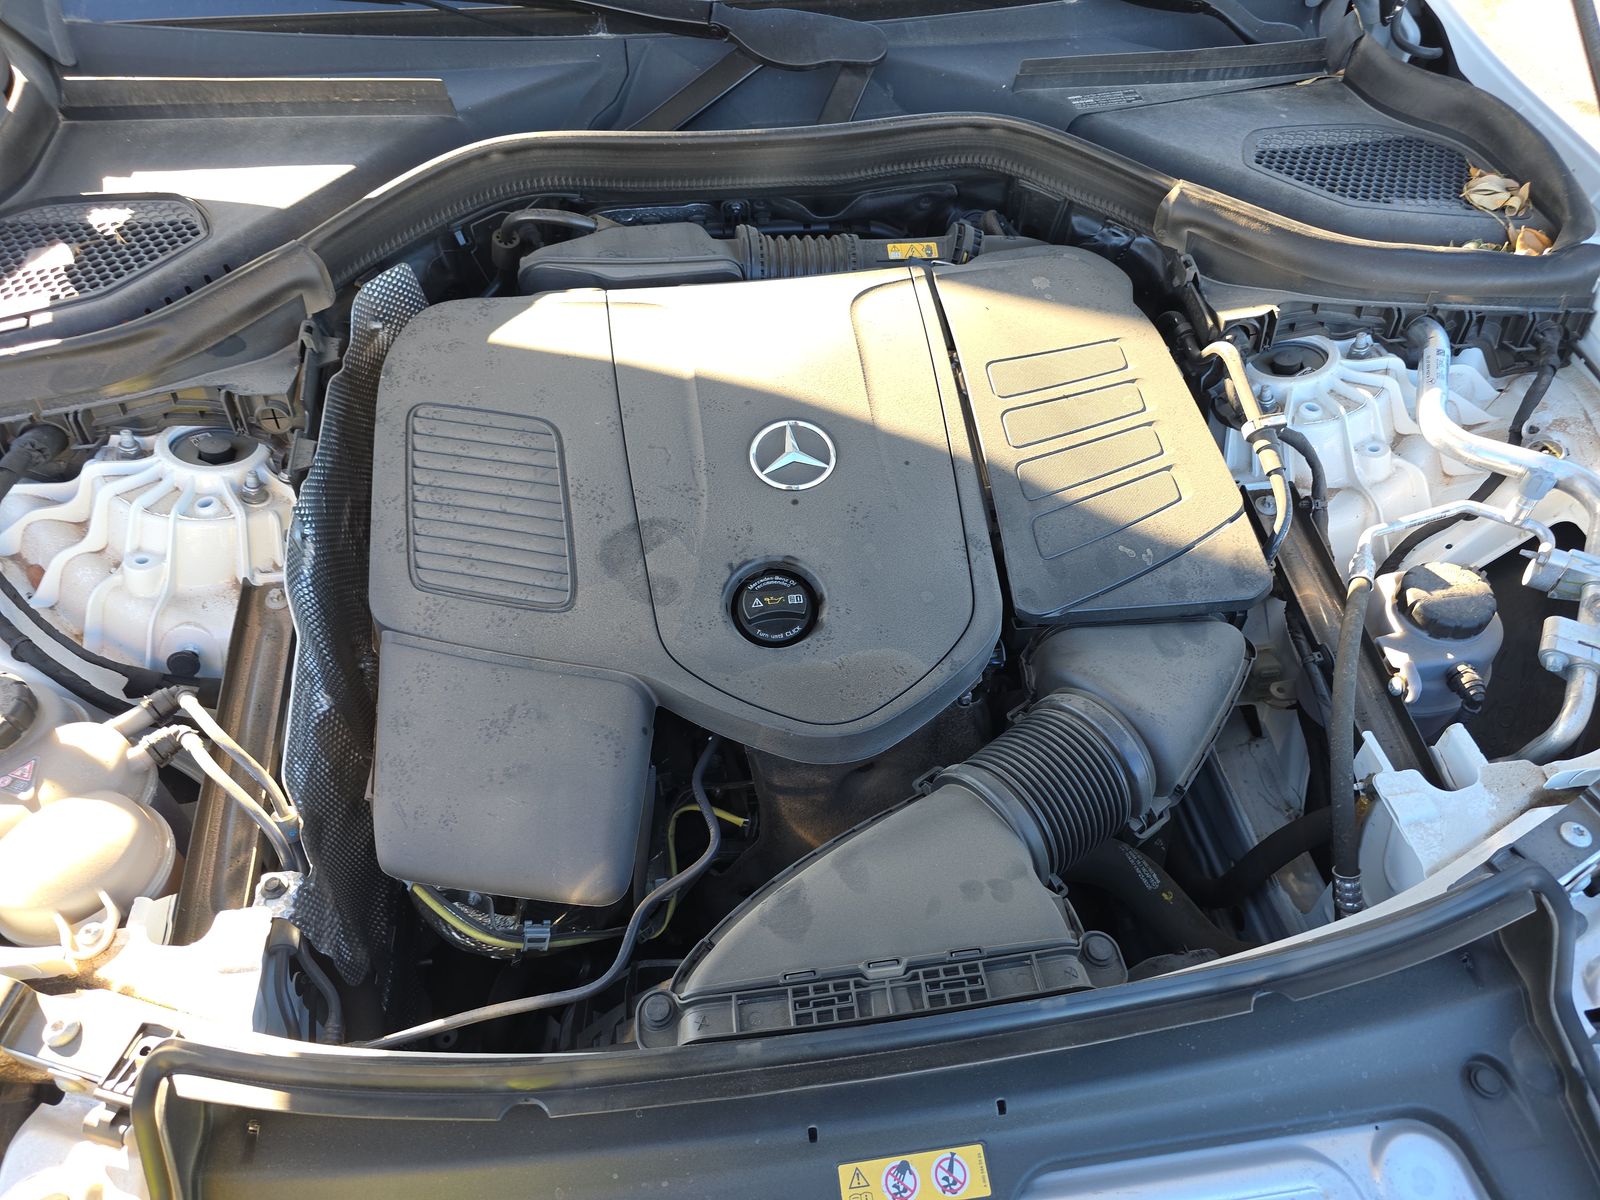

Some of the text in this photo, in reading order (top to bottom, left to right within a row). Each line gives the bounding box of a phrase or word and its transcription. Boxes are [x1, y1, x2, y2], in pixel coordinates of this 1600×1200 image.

[755, 580, 791, 590] recommended
[756, 629, 769, 638] Turn
[785, 625, 802, 637] CLICK
